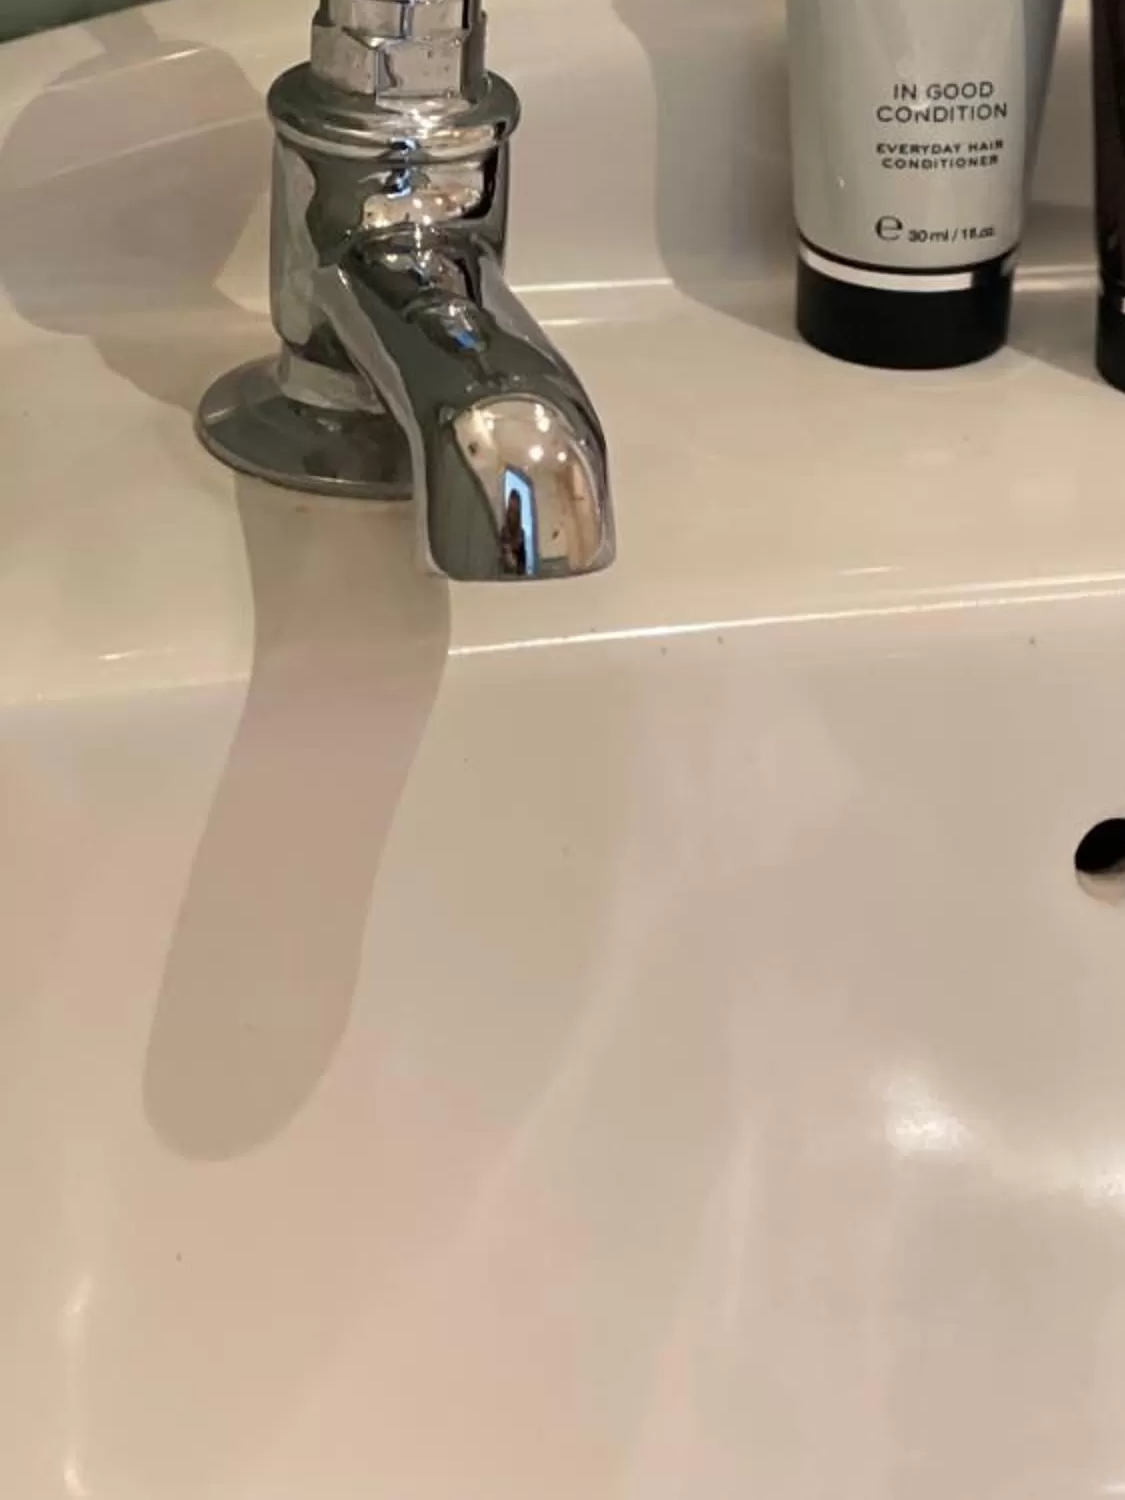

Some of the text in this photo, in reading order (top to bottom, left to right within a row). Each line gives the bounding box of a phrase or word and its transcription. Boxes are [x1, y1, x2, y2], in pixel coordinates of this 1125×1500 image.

[893, 81, 994, 100] IN GOOD
[876, 102, 1008, 123] CONDITION
[876, 139, 1004, 155] EVERYDAY HAIR
[881, 154, 999, 170] CONDITIONER
